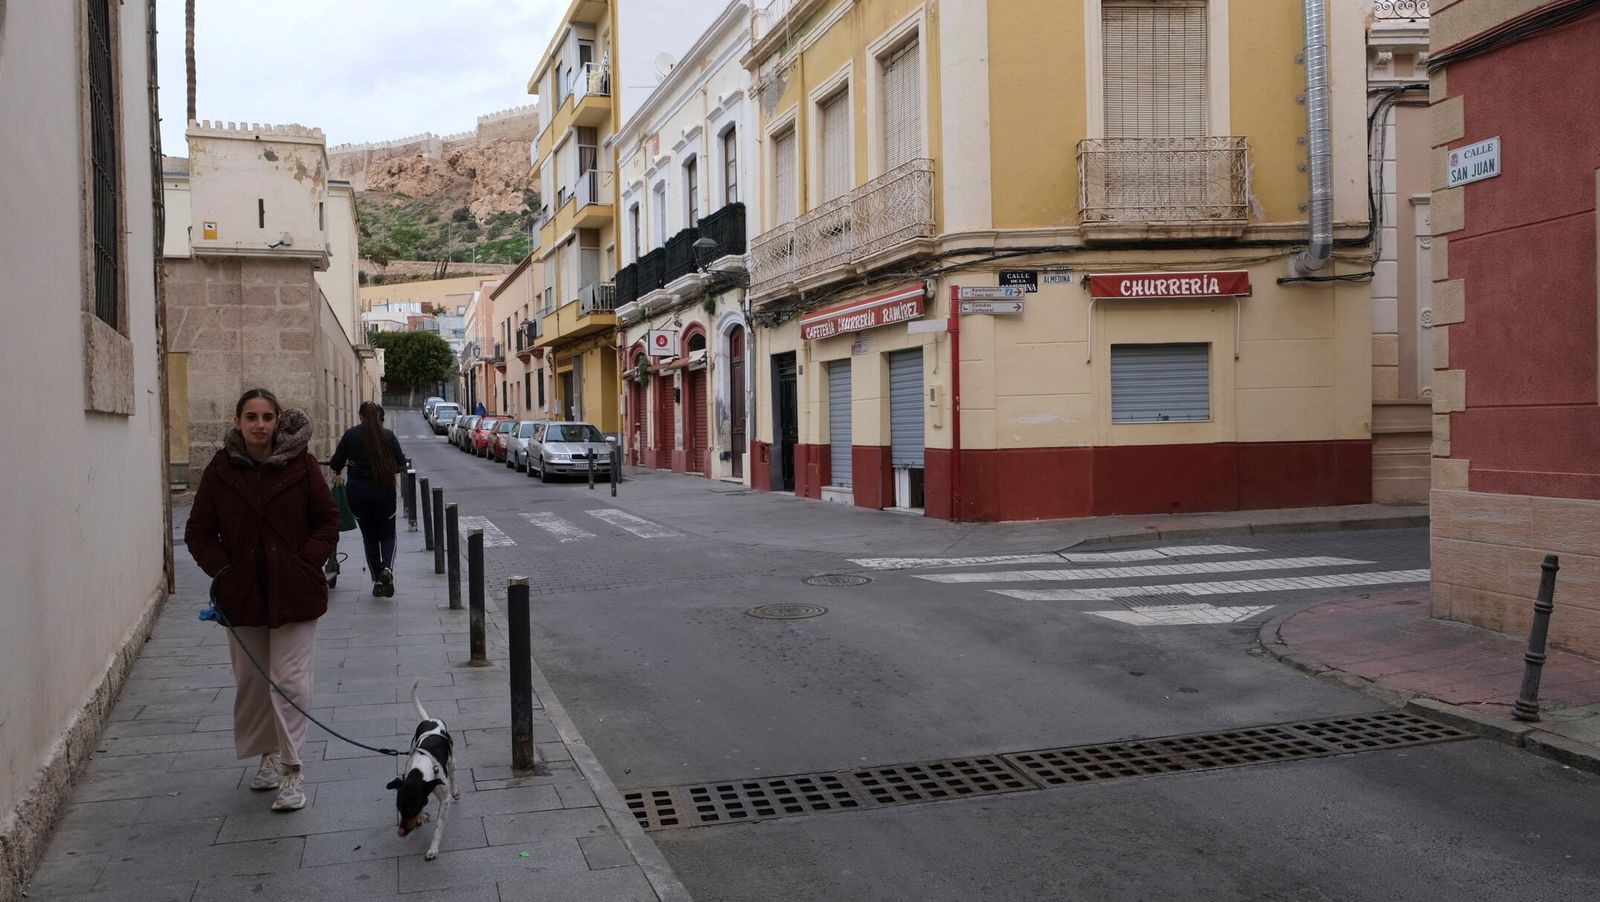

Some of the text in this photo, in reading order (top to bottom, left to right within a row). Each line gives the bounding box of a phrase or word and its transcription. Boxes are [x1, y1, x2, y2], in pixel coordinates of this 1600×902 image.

[1464, 143, 1494, 159] CALLE
[1451, 158, 1495, 183] SAN JUAN
[1043, 275, 1071, 283] ALMEDINA
[1120, 274, 1220, 296] CHURRERÍA
[806, 319, 836, 340] CAFETERÍA
[882, 301, 919, 323] RAMÍREZ
